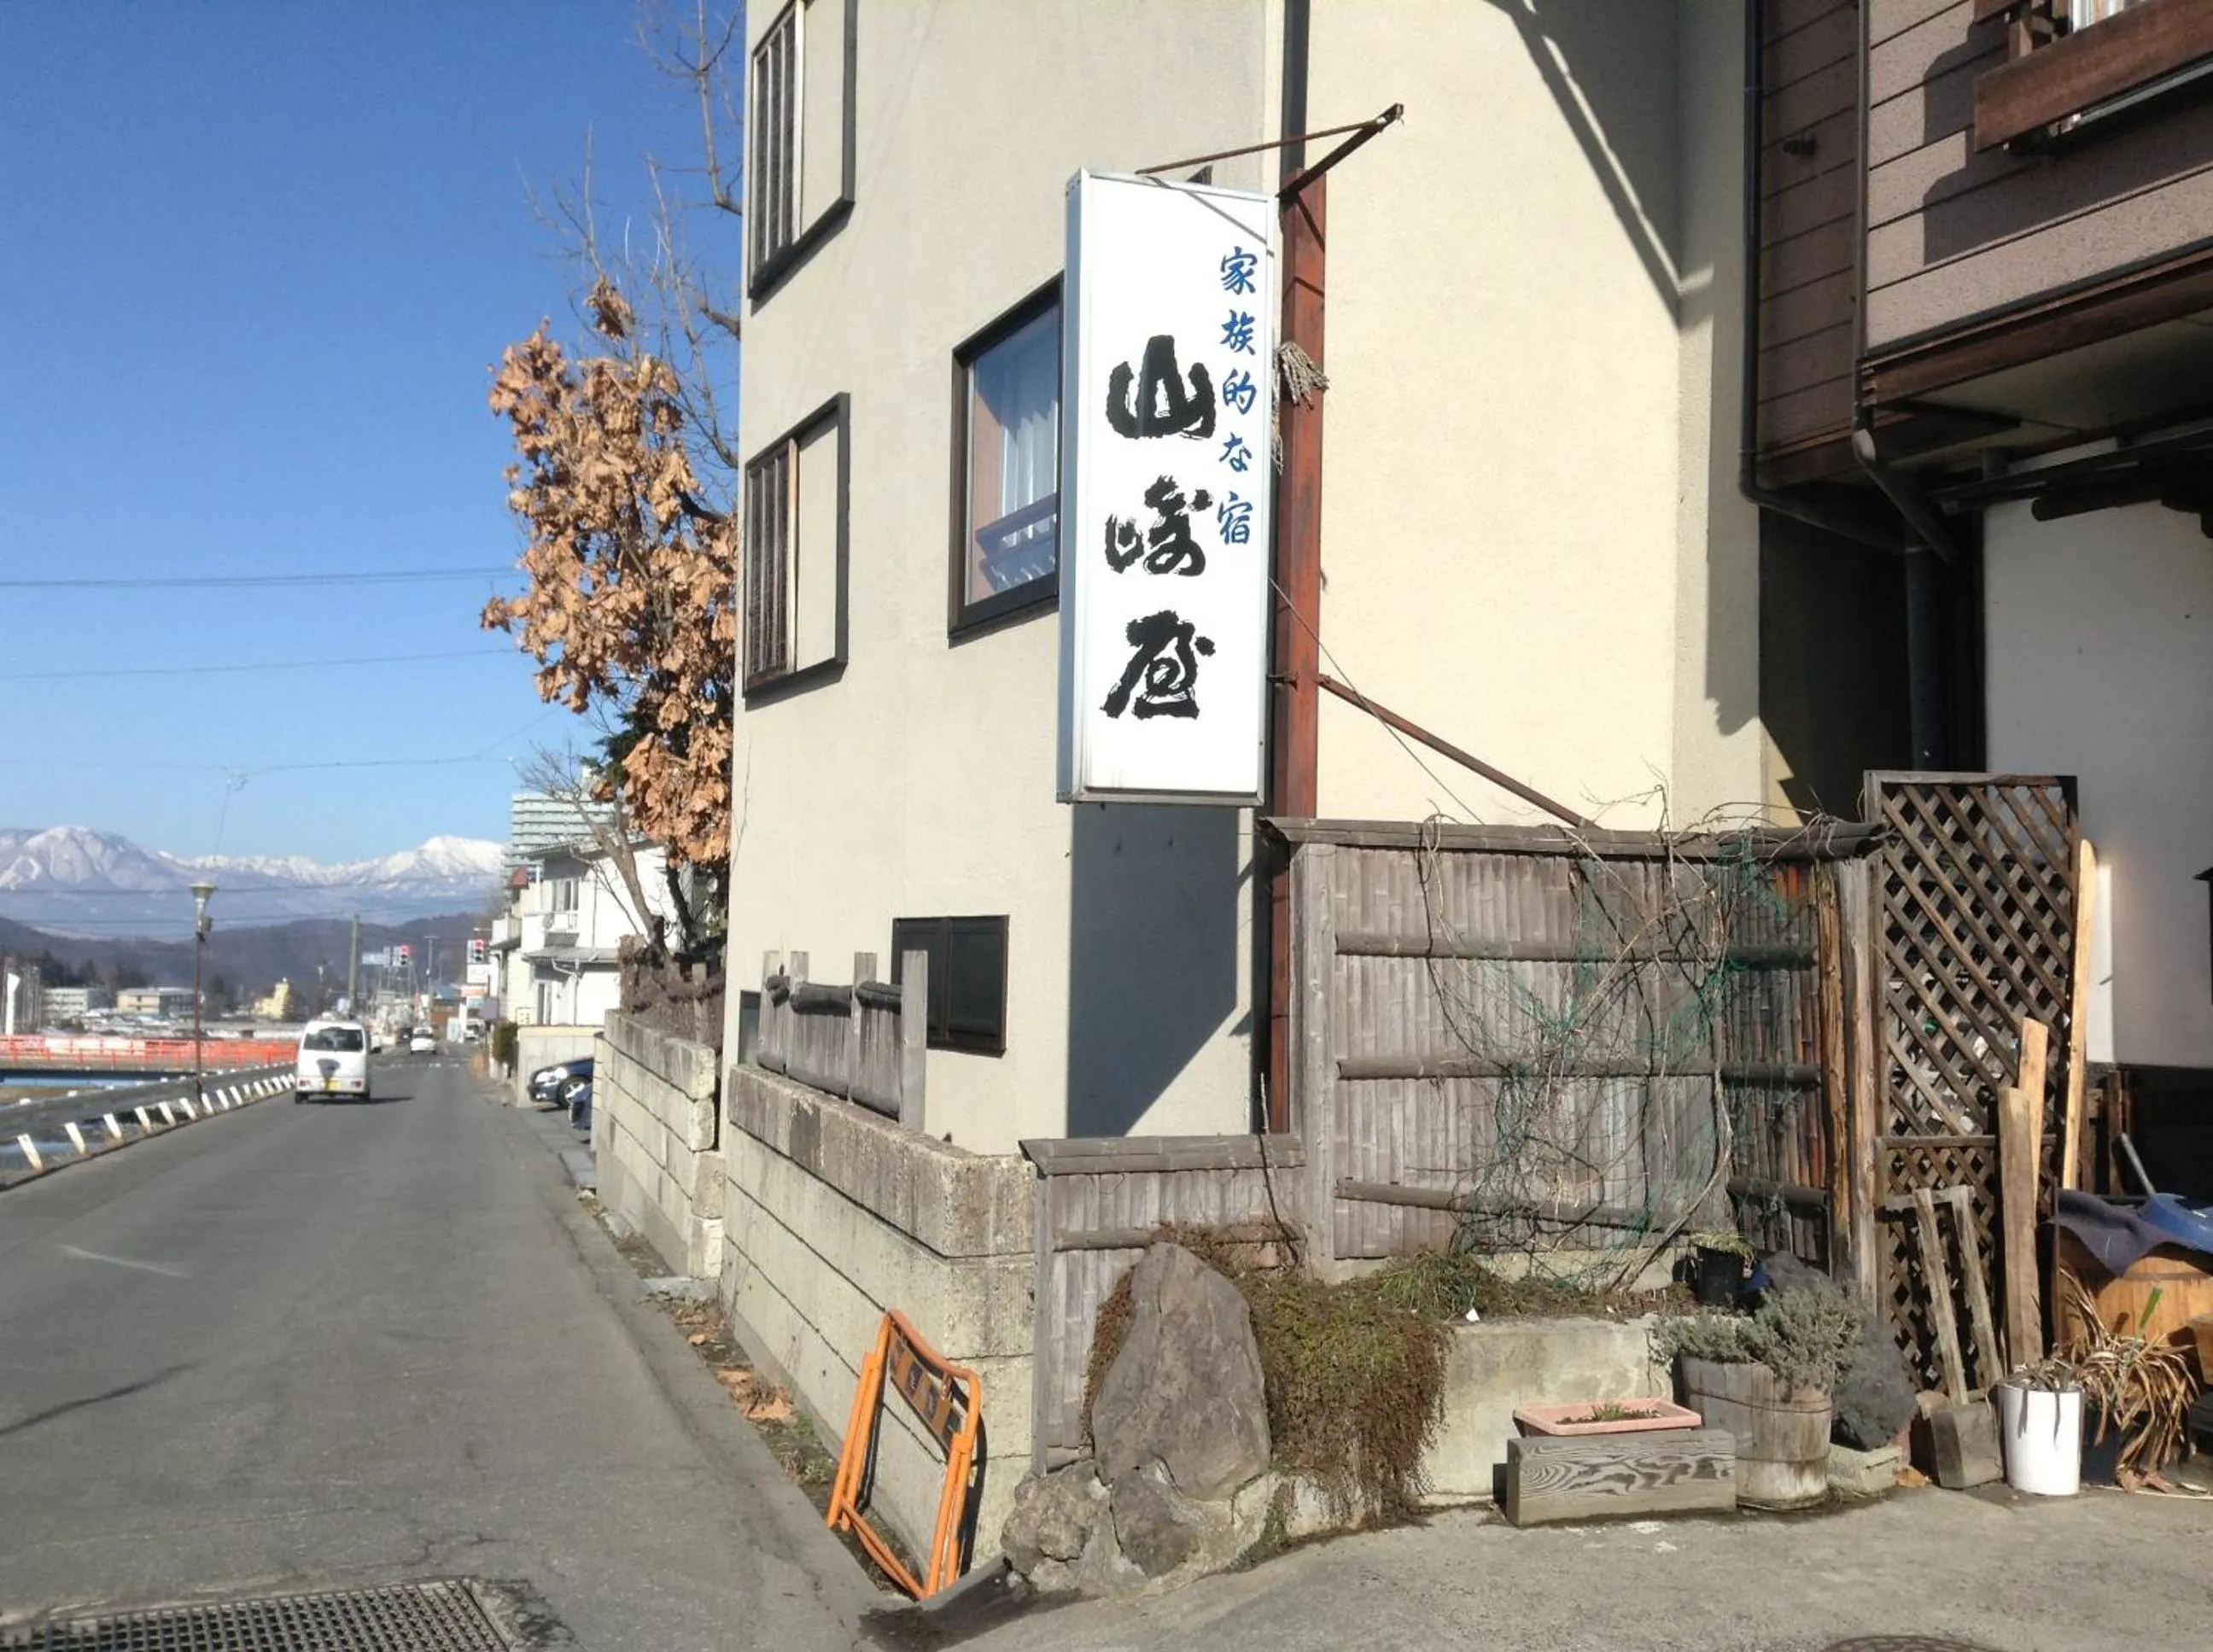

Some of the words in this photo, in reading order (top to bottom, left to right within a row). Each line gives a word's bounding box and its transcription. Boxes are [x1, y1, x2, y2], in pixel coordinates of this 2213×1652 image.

[1217, 246, 1258, 546] 家族的な宿
